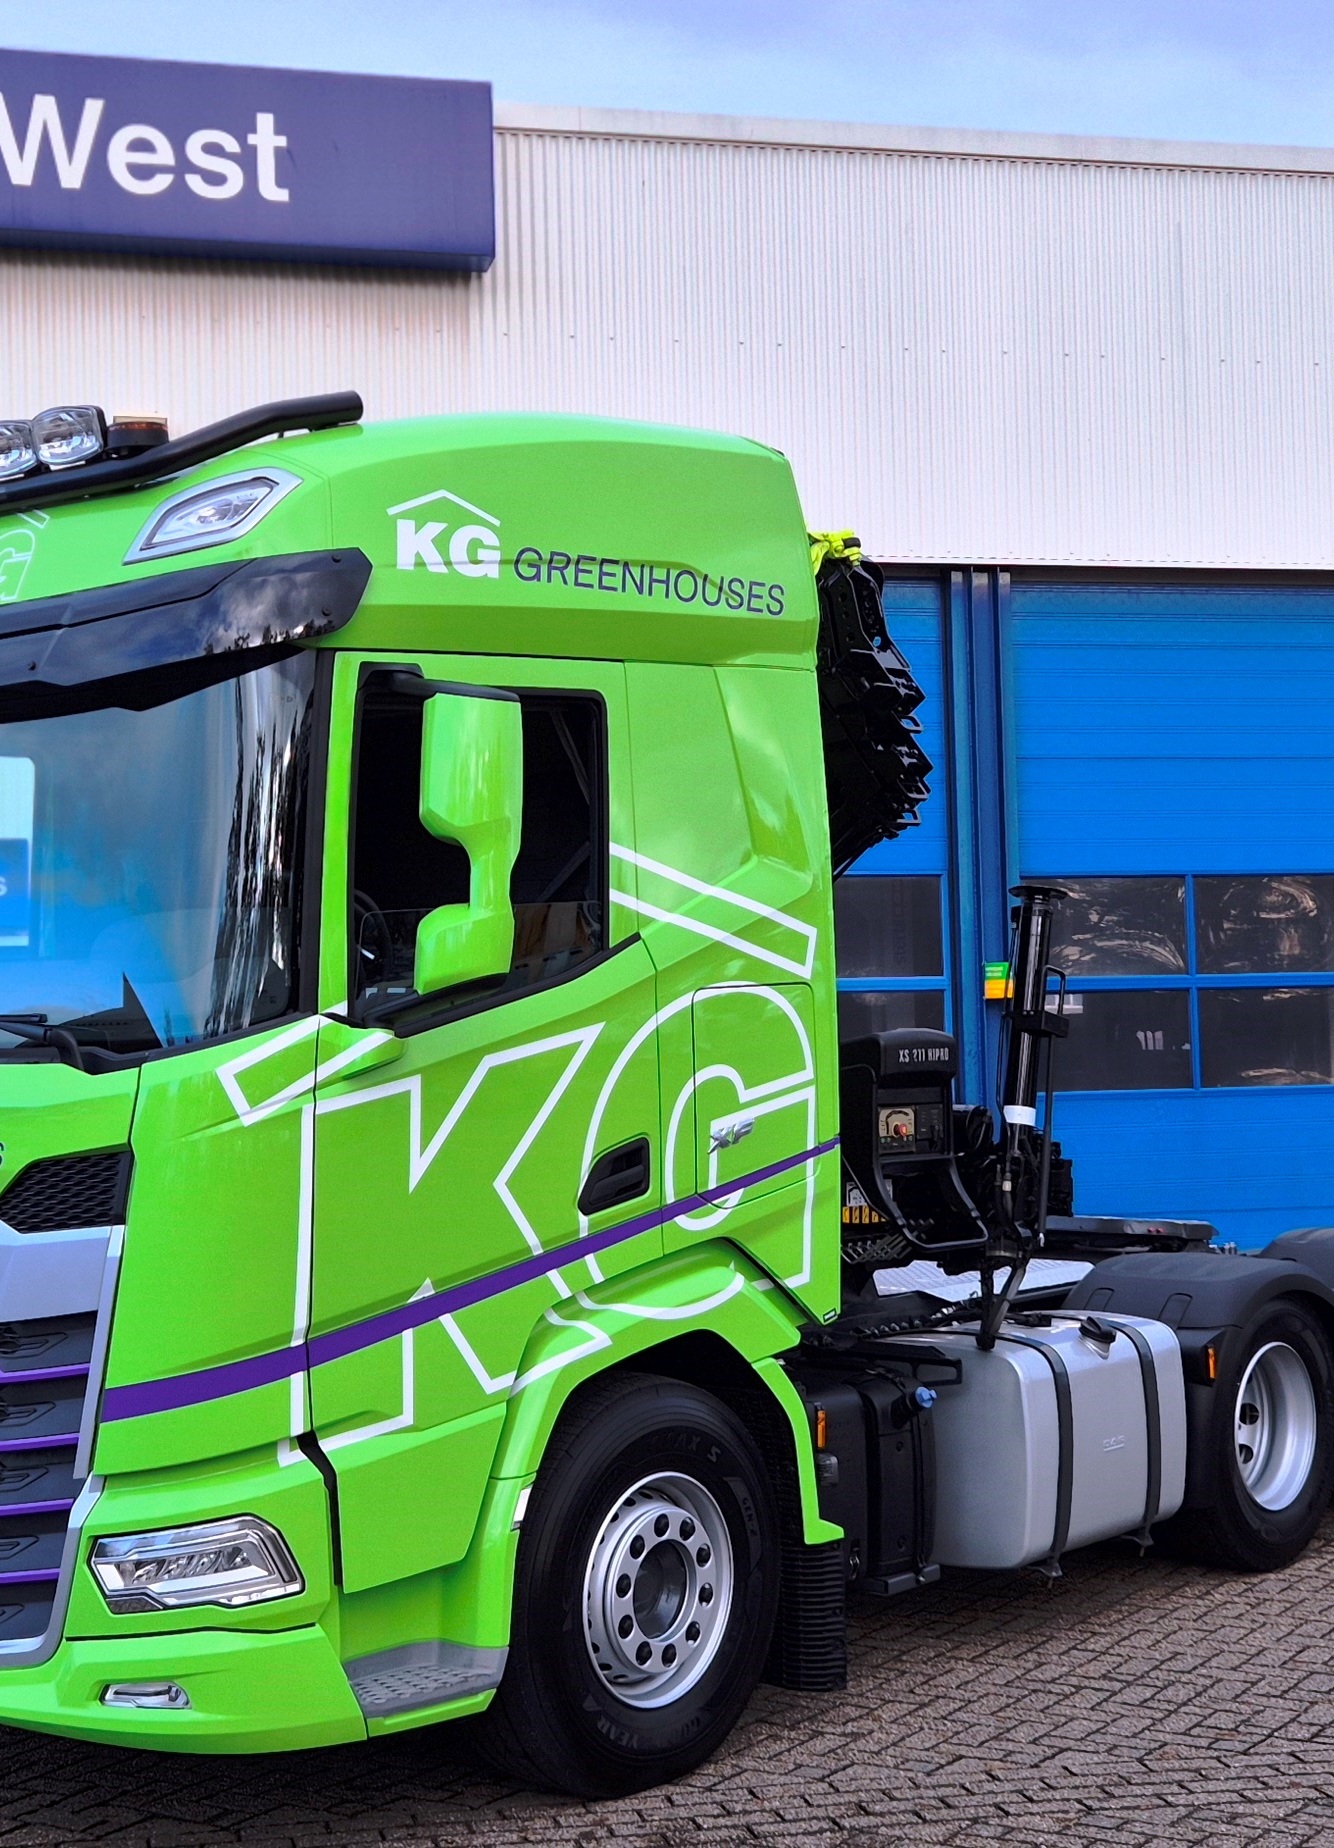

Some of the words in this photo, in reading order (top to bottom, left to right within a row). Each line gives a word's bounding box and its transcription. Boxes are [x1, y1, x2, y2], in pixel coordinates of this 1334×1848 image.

[396, 518, 501, 580] KG
[513, 547, 785, 616] GREENHOUSES
[898, 1049, 910, 1063] XS
[278, 981, 816, 1468] KG
